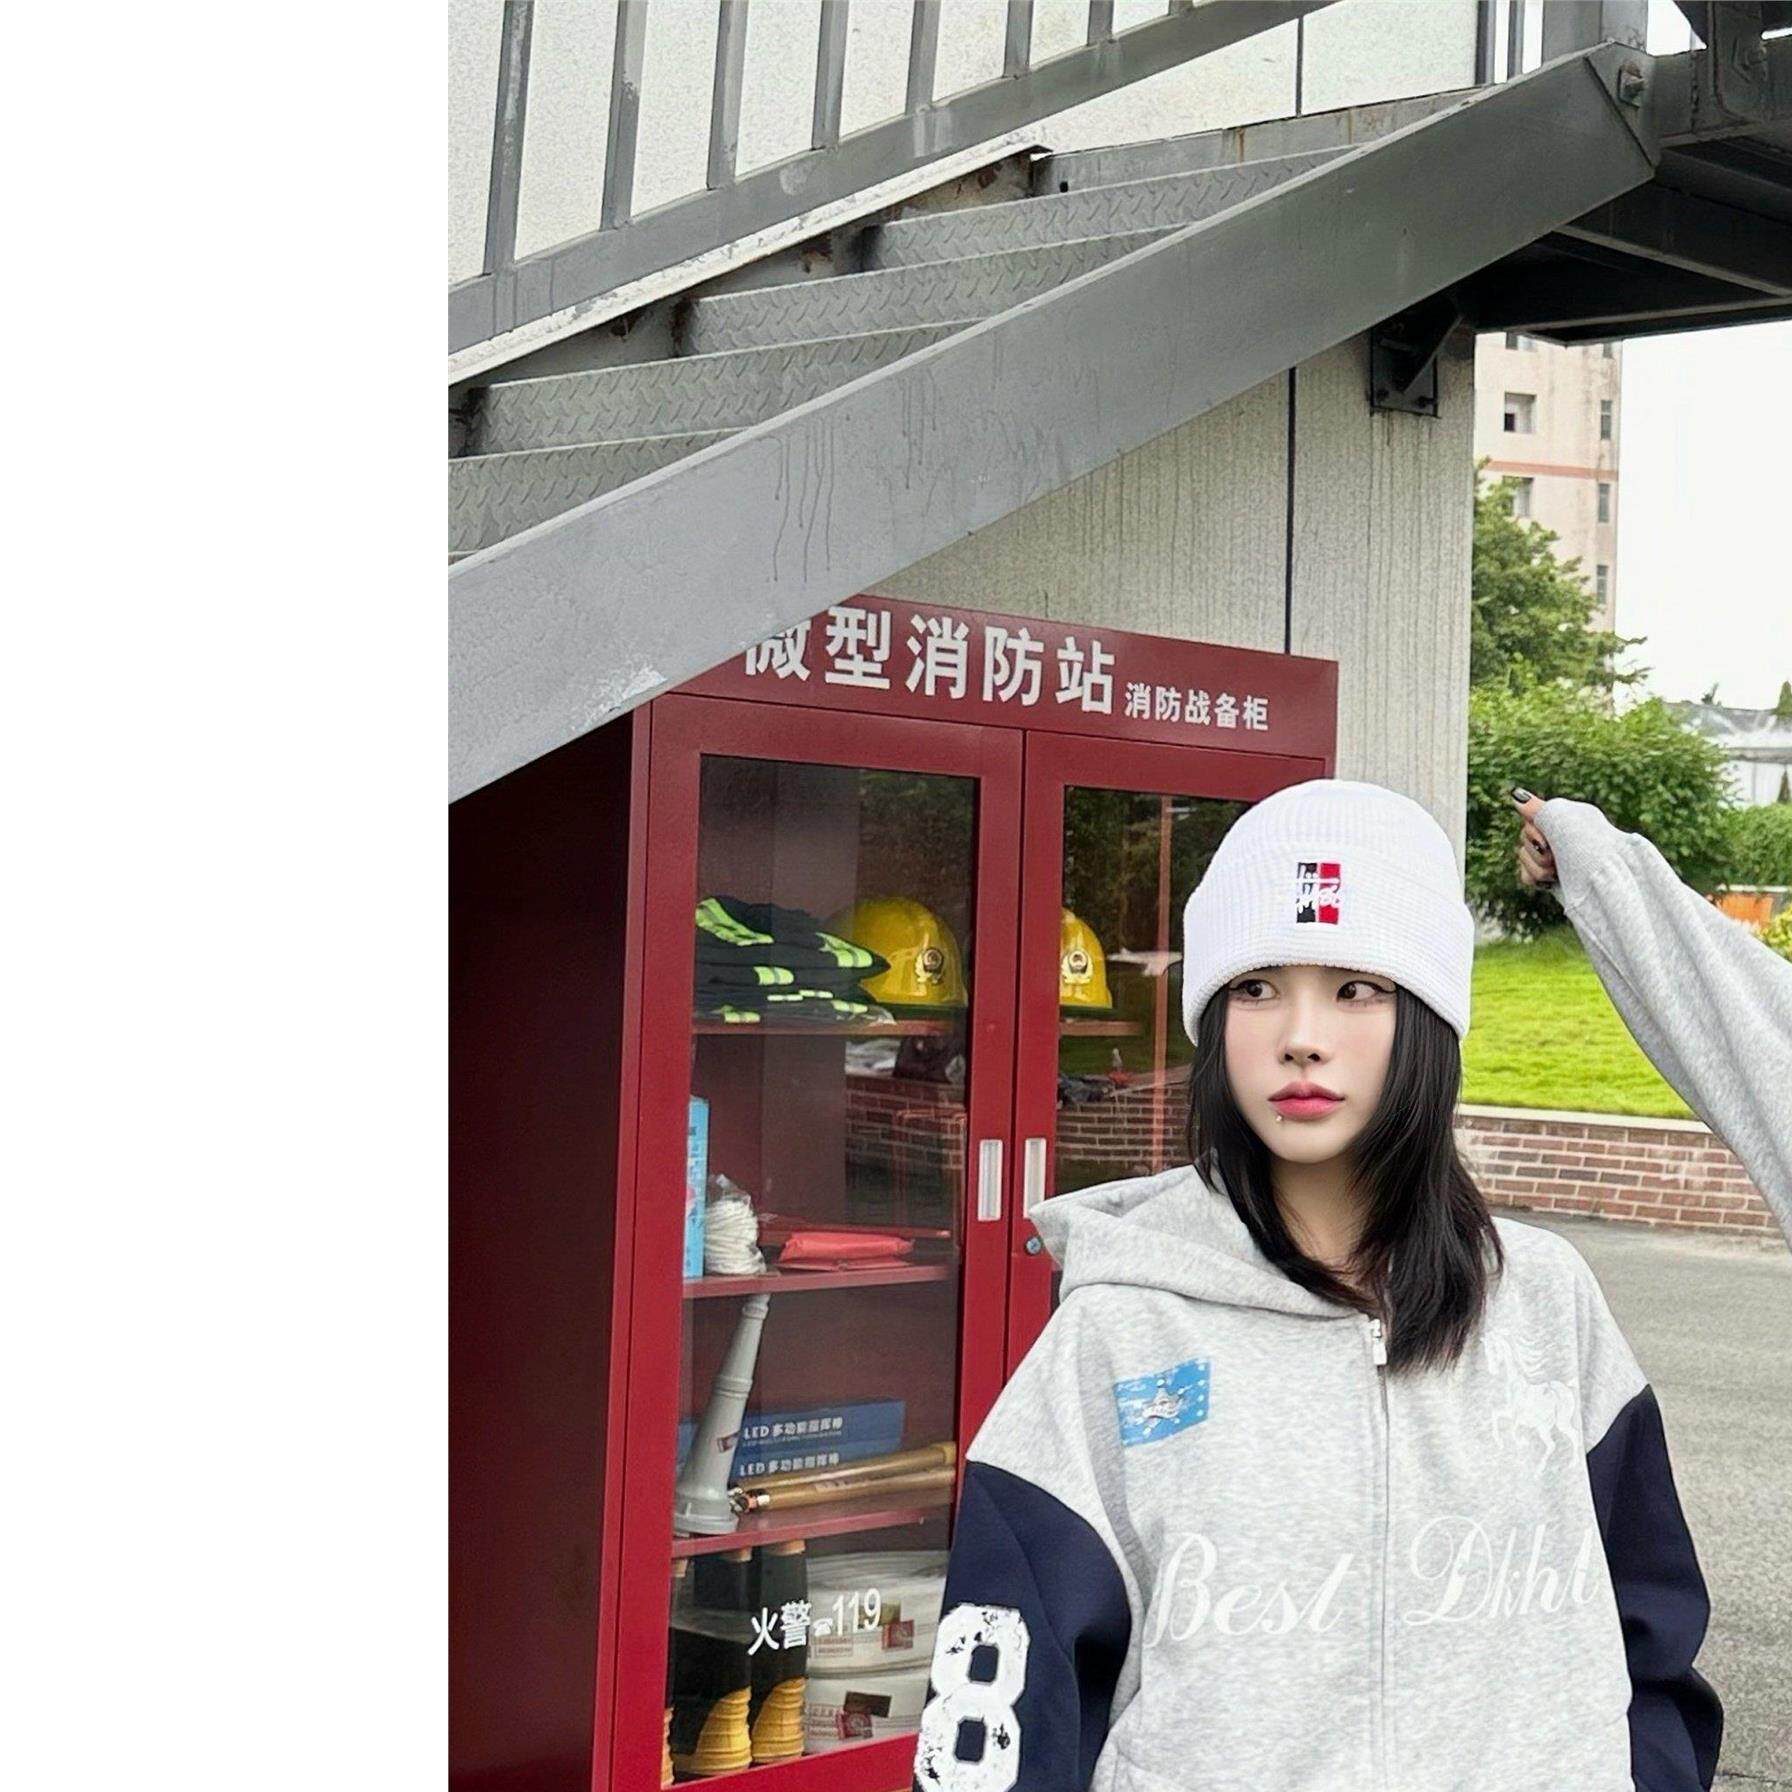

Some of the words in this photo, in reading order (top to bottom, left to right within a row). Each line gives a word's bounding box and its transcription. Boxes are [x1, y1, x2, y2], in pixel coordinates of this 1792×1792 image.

[1125, 682, 1269, 731] 消防战备柜
[744, 1425, 769, 1440] LED
[739, 1461, 766, 1477] LED
[1142, 1532, 1358, 1648] Best
[747, 1599, 813, 1656] 火警
[832, 1588, 881, 1636] 119
